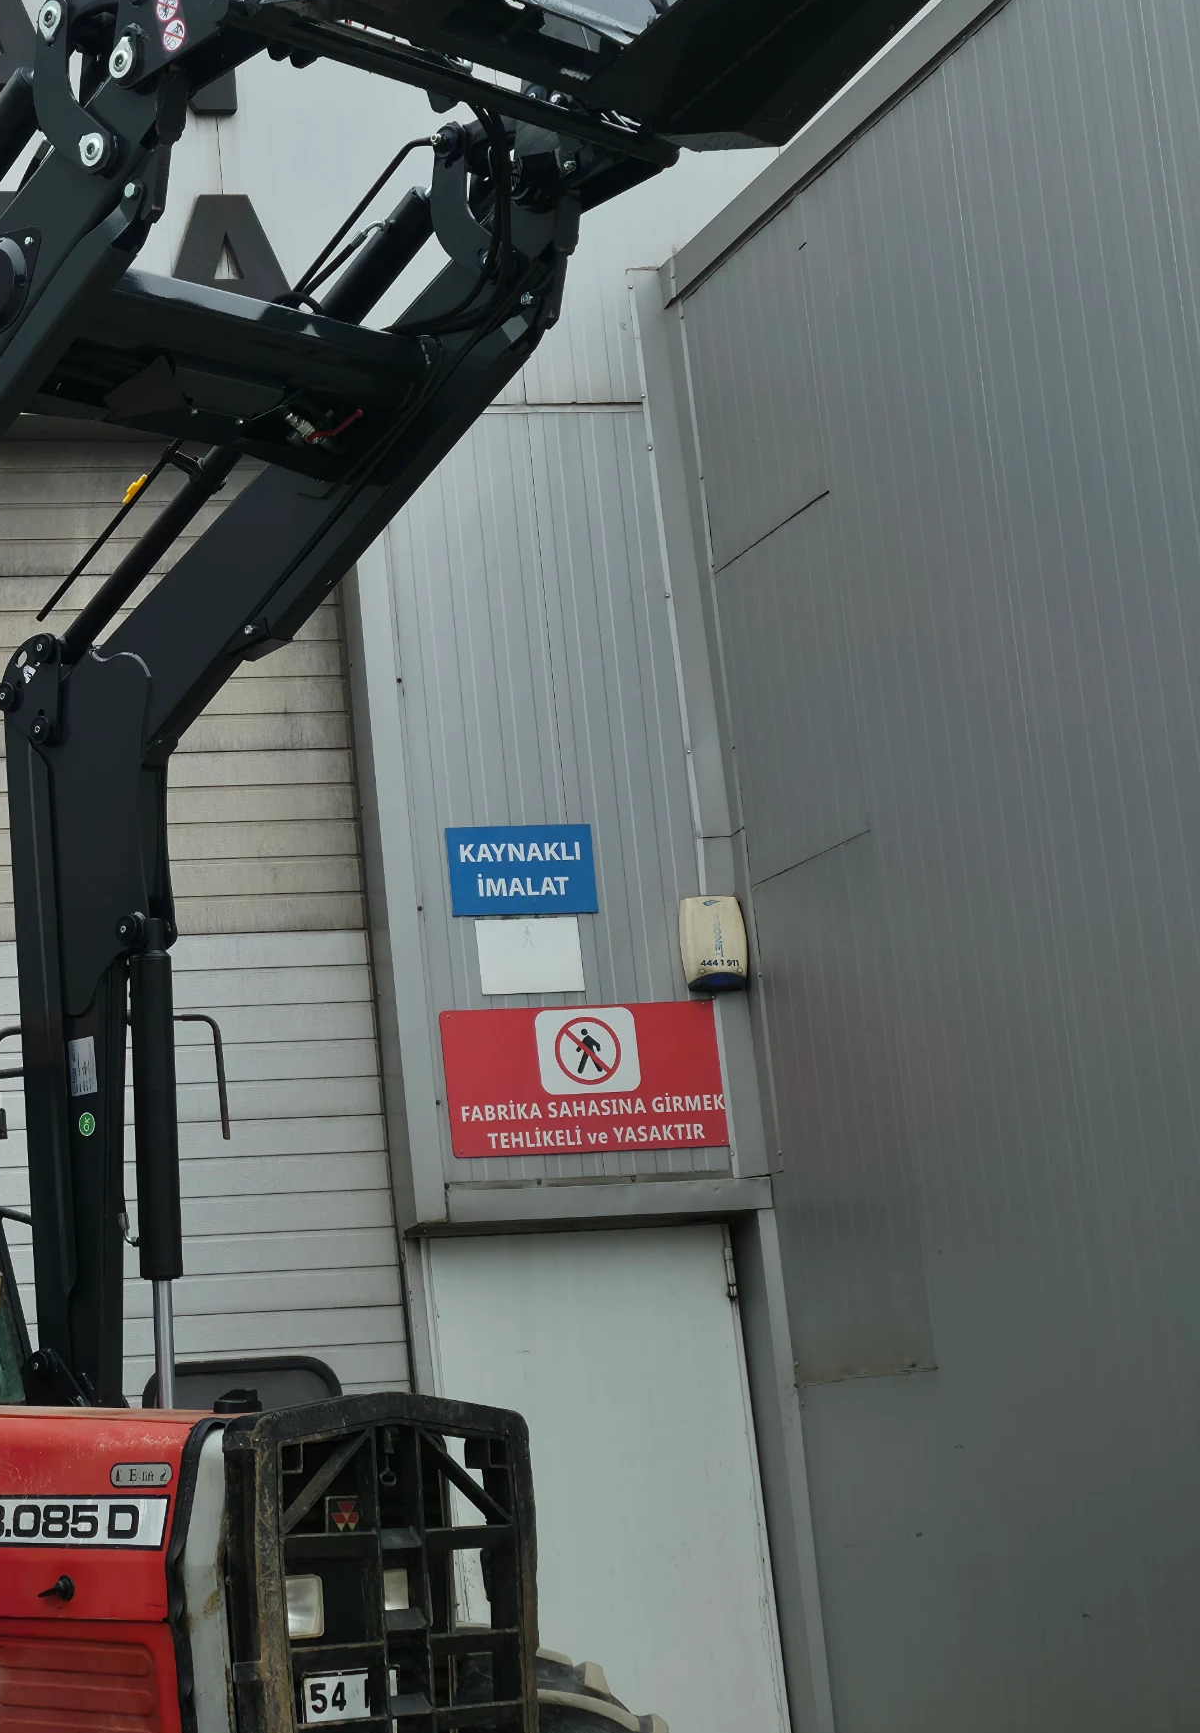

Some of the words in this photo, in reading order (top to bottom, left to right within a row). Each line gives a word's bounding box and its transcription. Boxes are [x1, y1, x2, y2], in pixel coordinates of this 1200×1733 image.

[459, 841, 581, 863] KAYNAKLI
[478, 873, 569, 897] İMALAT
[700, 959, 719, 967] 444
[726, 959, 740, 967] 911
[460, 1099, 543, 1123] FABRİKA
[548, 1097, 647, 1119] SAHASINA
[651, 1092, 726, 1113] GİRMEK
[83, 1117, 90, 1131] OK
[487, 1125, 582, 1149] TEHLİKELİ
[587, 1132, 608, 1145] ve
[613, 1123, 706, 1143] YASAKTIR
[107, 1504, 140, 1540] D
[309, 1681, 347, 1714] 54
